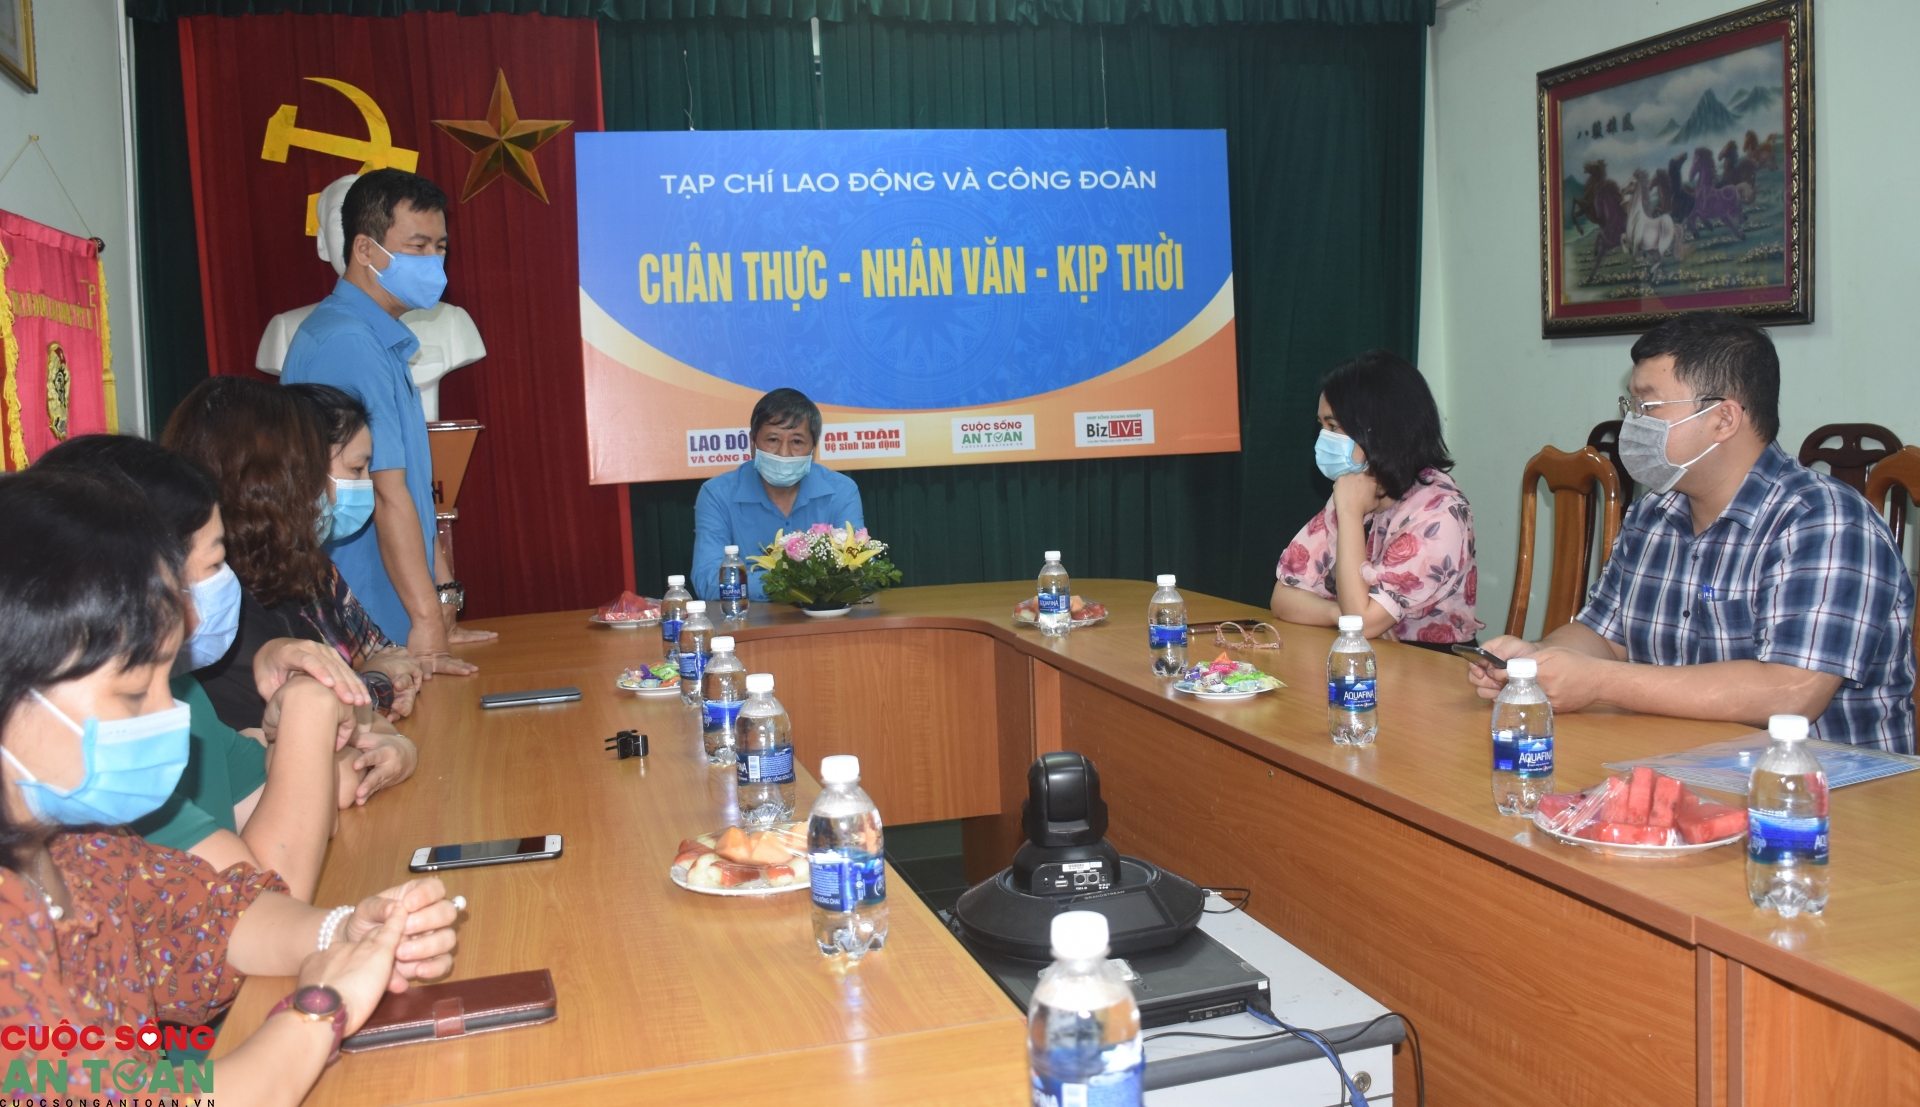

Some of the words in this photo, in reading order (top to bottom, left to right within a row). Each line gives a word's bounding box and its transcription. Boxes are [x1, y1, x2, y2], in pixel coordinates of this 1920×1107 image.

[660, 174, 716, 199] TẠP
[724, 169, 774, 194] CHÍ
[783, 172, 840, 193] LAO
[848, 168, 936, 197] ĐỘNG
[942, 167, 980, 191] VÀ
[987, 166, 1071, 190] CÔNG
[1079, 166, 1157, 189] ĐOÀN
[638, 242, 733, 304] CHÂN
[742, 245, 828, 312] THỰC
[861, 237, 953, 298] NHÂN
[961, 236, 1026, 295] VĂN
[1057, 245, 1108, 303] KỊP
[1116, 232, 1185, 291] THỜI
[961, 421, 991, 432] CUỘC
[994, 419, 1022, 430] SỐNG
[689, 434, 721, 452] LAO
[725, 430, 749, 452] ĐỘ
[825, 432, 848, 442] AN
[854, 429, 900, 441] TOÀN
[962, 433, 981, 444] AN
[839, 441, 859, 450] sinh
[862, 441, 876, 449] lao
[879, 440, 900, 450] động
[690, 454, 705, 464] VÀ
[708, 453, 739, 463] CÔNG
[1344, 690, 1375, 701] AQUAFINA
